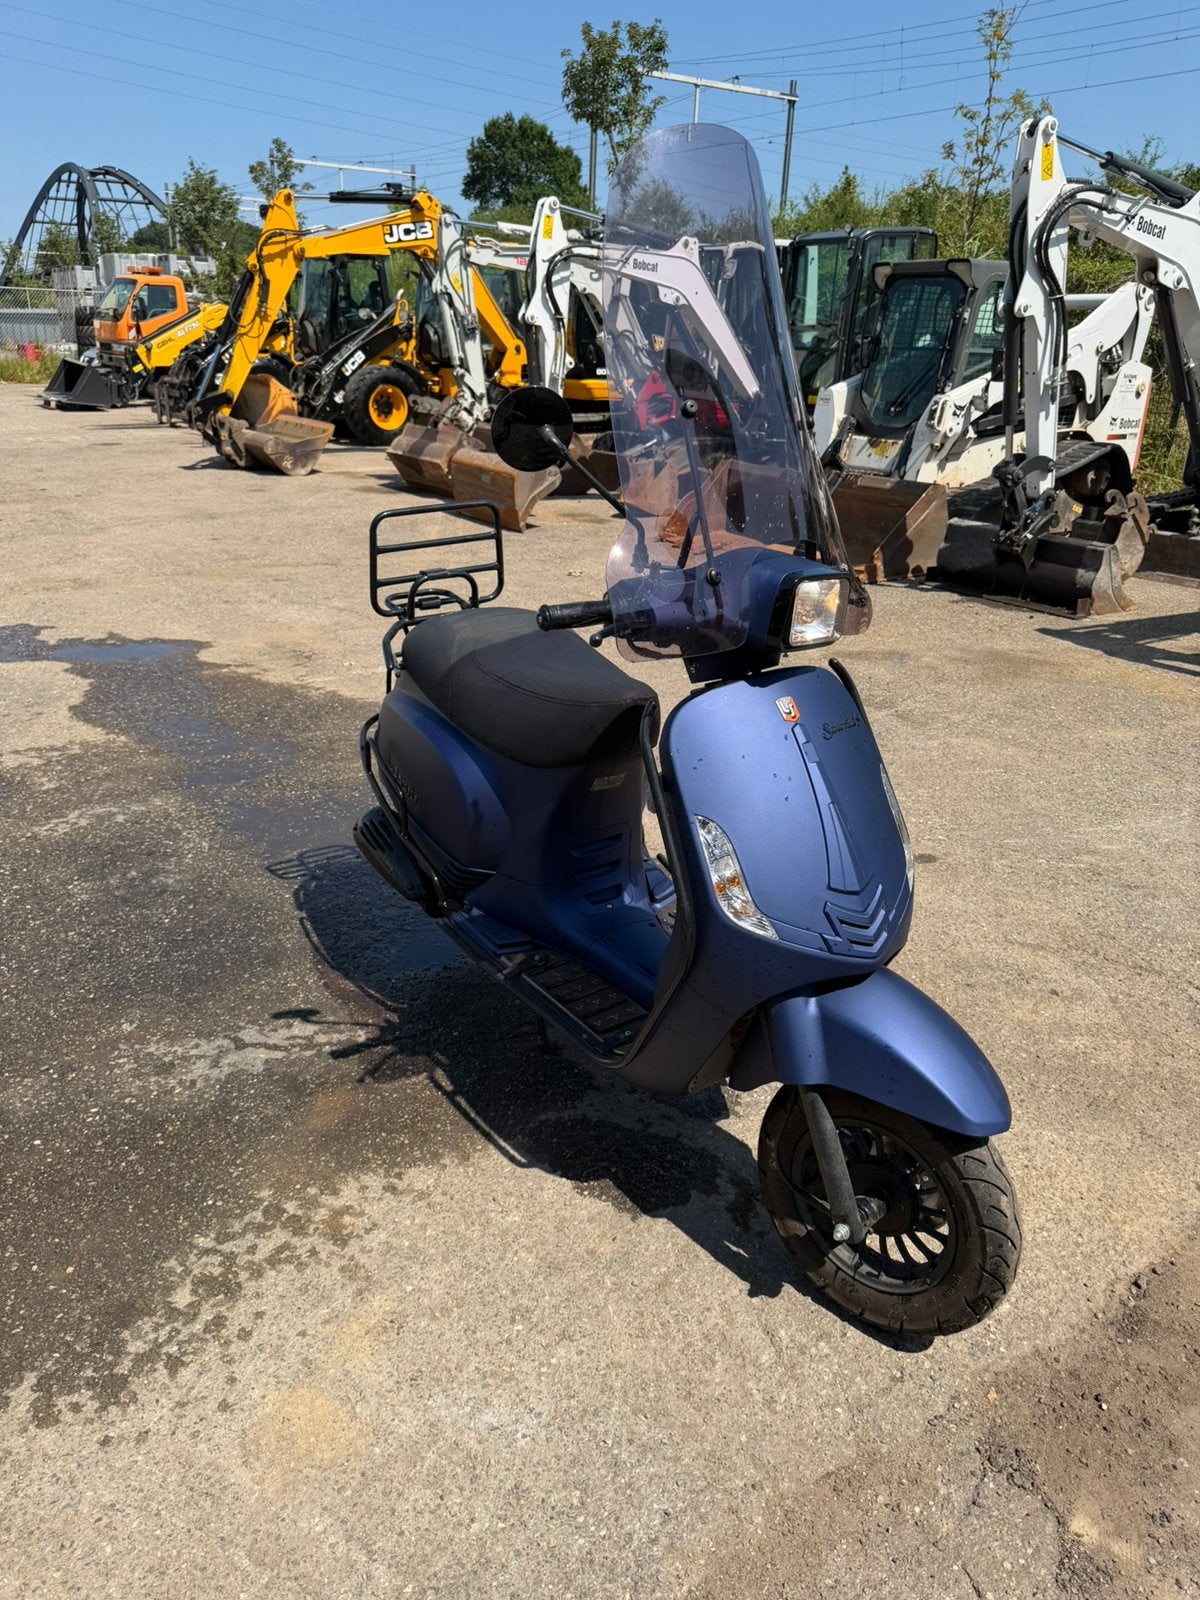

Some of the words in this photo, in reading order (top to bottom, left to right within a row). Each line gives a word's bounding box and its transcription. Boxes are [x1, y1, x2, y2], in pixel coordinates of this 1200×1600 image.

[384, 221, 433, 243] JCB
[1136, 215, 1166, 240] Bobcat
[632, 258, 659, 273] Bobcat
[342, 350, 366, 377] JCB
[1119, 417, 1141, 429] Bobcat
